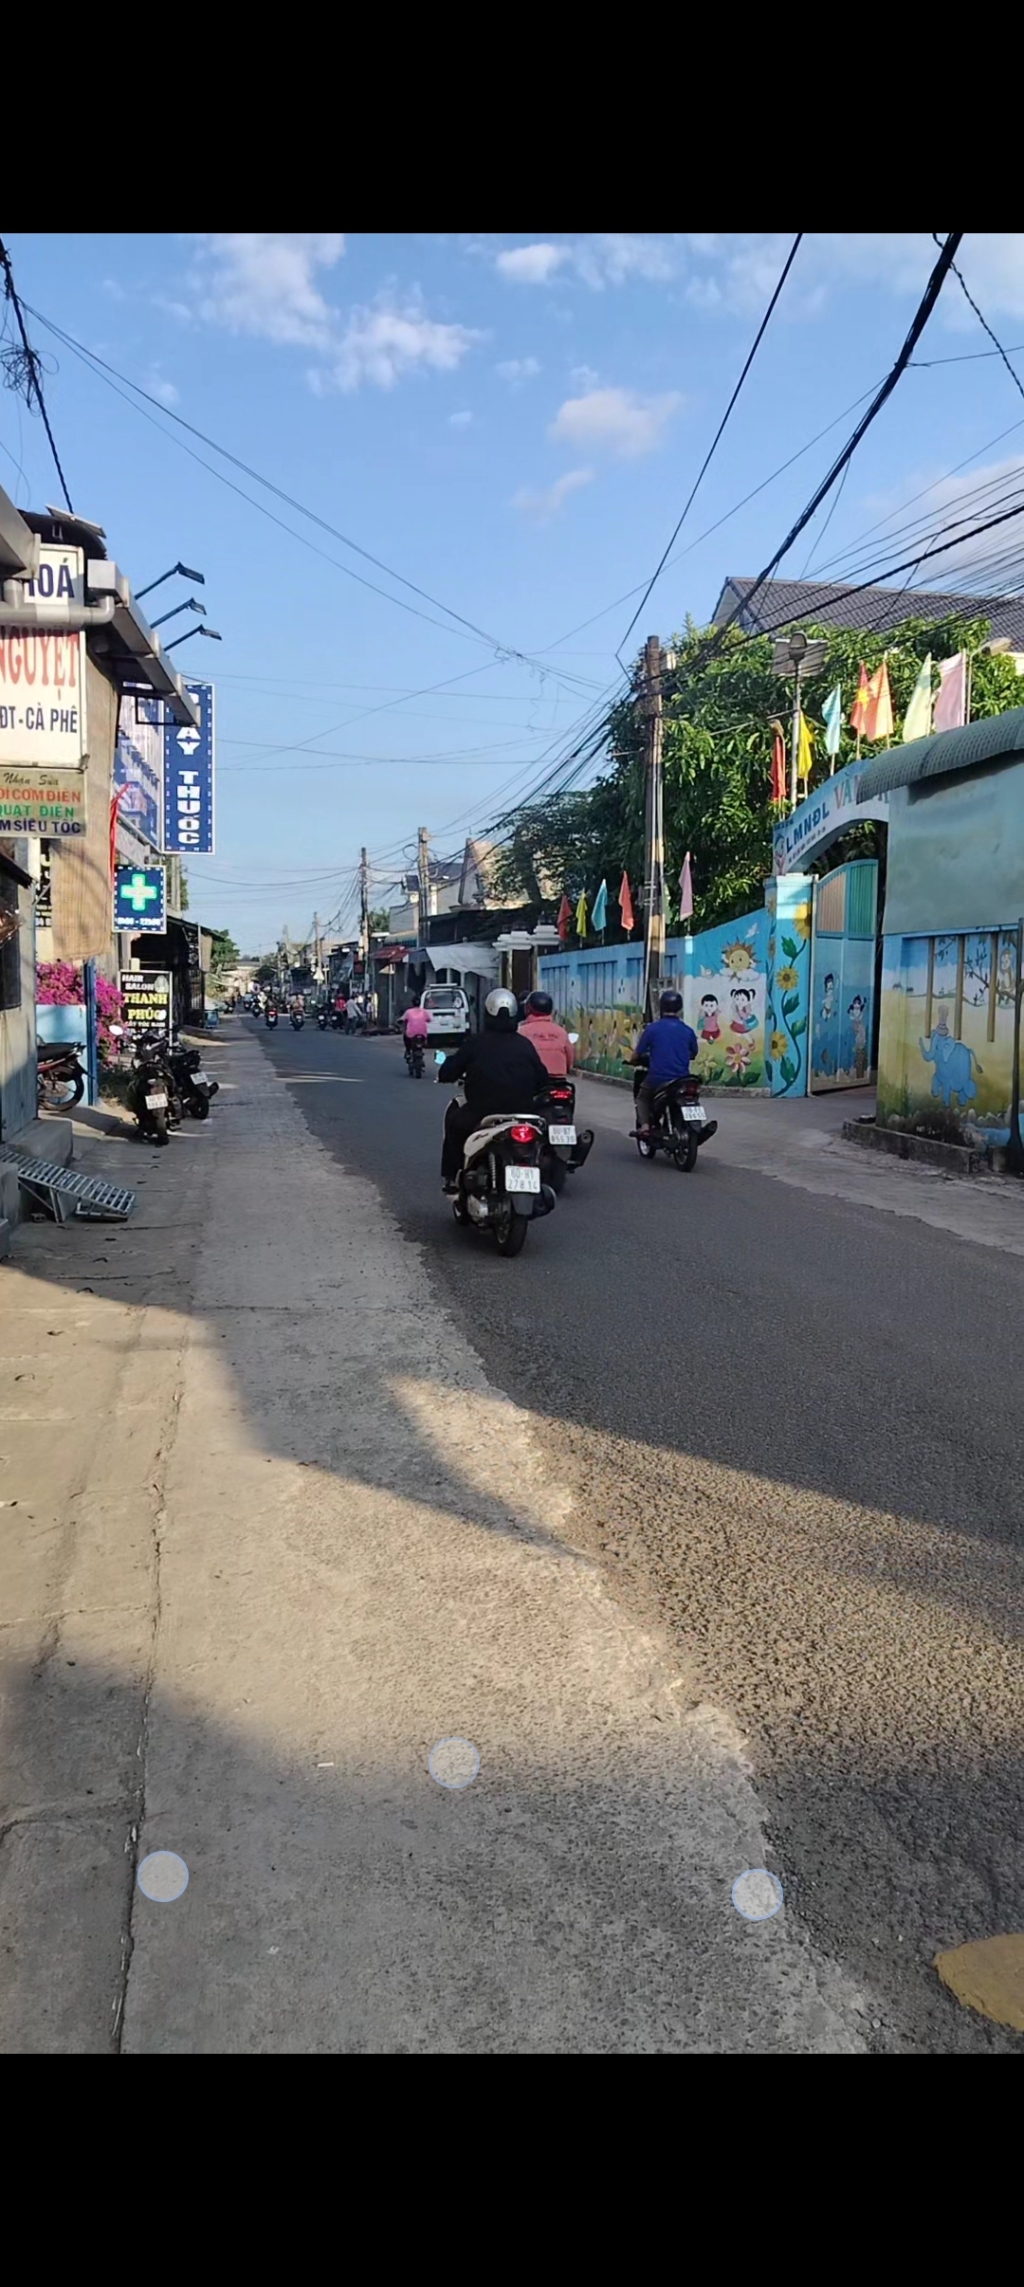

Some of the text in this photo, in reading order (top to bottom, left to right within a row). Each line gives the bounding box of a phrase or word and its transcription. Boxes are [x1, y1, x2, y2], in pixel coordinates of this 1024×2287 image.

[50, 705, 78, 733] PHÊ
[0, 803, 31, 819] UẠT
[122, 974, 144, 982] HAIR
[125, 982, 154, 991] SALON
[123, 993, 167, 1005] THANH
